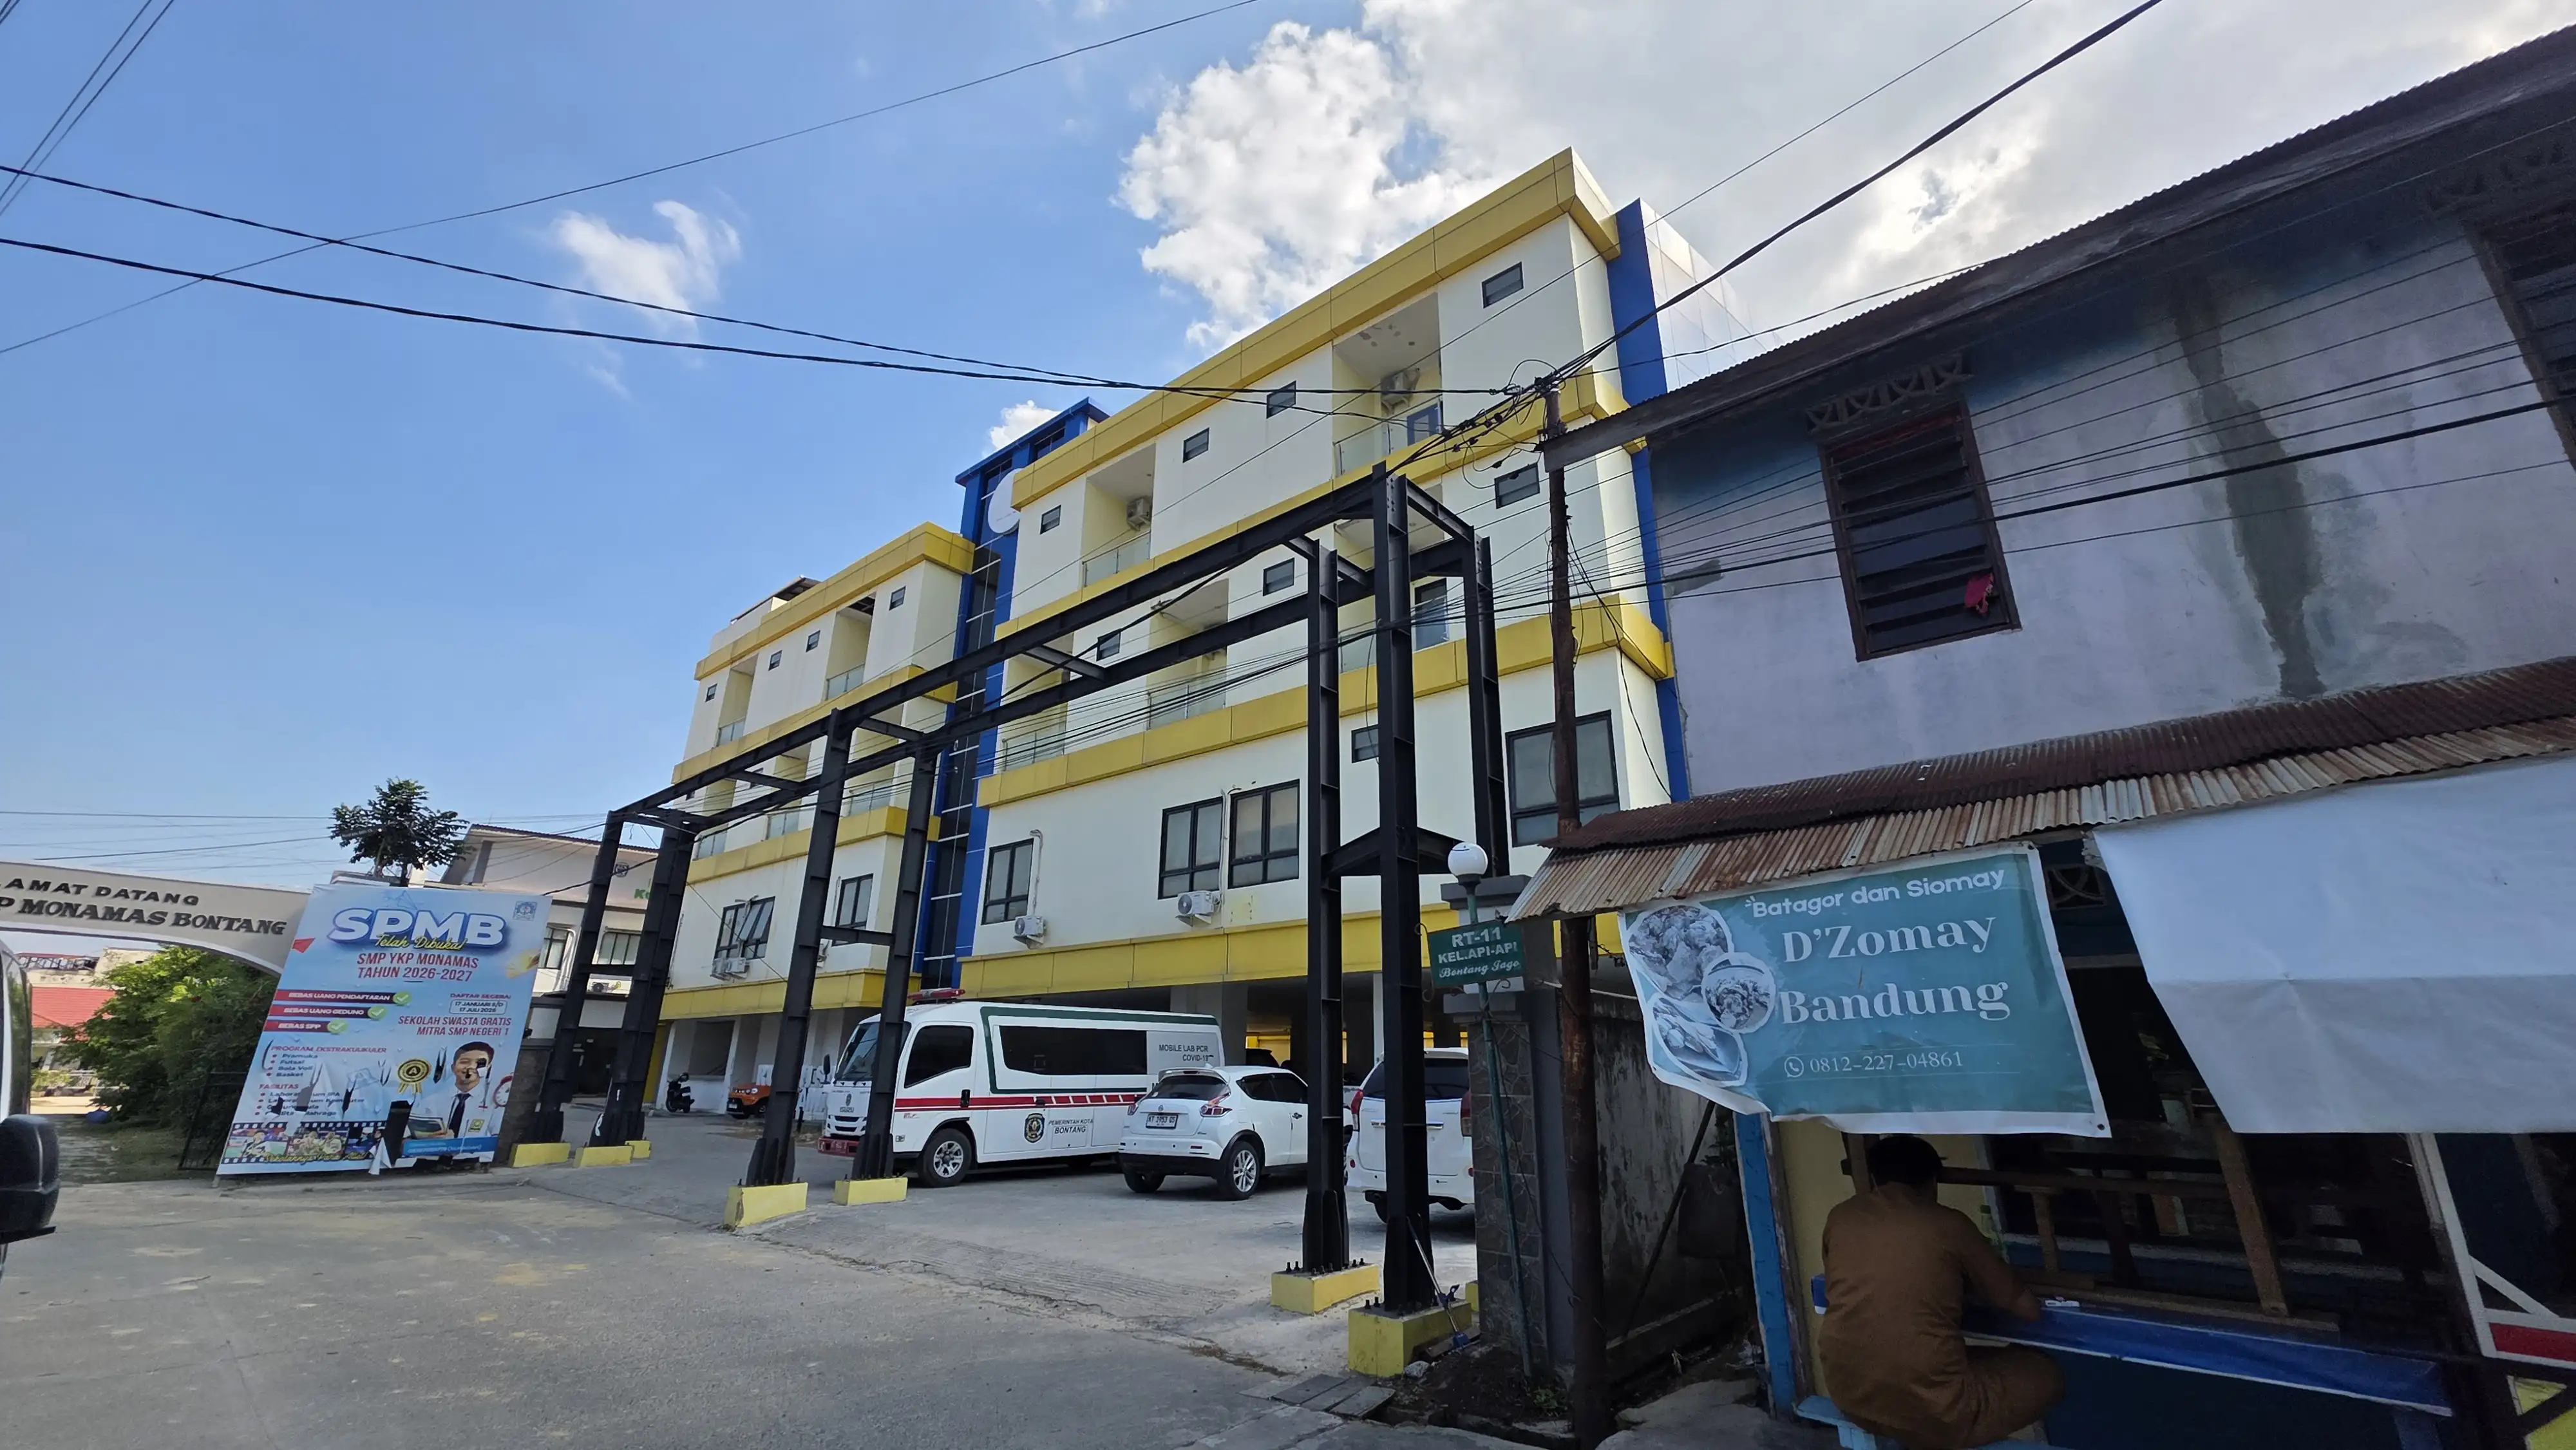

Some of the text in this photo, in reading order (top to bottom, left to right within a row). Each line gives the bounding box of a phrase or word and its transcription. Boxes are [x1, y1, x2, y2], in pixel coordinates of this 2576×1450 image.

[0, 878, 200, 906] AMAT DATANG
[1751, 869, 2005, 918] Batagor dan Siomay
[18, 899, 168, 925] MONAMAS
[172, 912, 287, 935] BONTANG
[327, 908, 507, 947] SPMB
[375, 934, 467, 951] Telah Dibuka!
[1452, 927, 1501, 948] RT-11
[1781, 916, 1997, 964] D'Zomay
[357, 953, 479, 969] SMP YKP MONAMAS
[1438, 941, 1517, 964] KEL.API-API
[357, 967, 473, 982] TAHUN 2026-2027
[1439, 965, 1489, 978] Bontang
[1779, 979, 2011, 1025] Bandung
[398, 1016, 512, 1026] SEKOLAH SWASTA GRATIS
[417, 1027, 446, 1035] MITRA
[448, 1027, 468, 1035] SMP
[469, 1028, 502, 1036] NEGERI
[1810, 1051, 1964, 1074] 0812-227-04861
